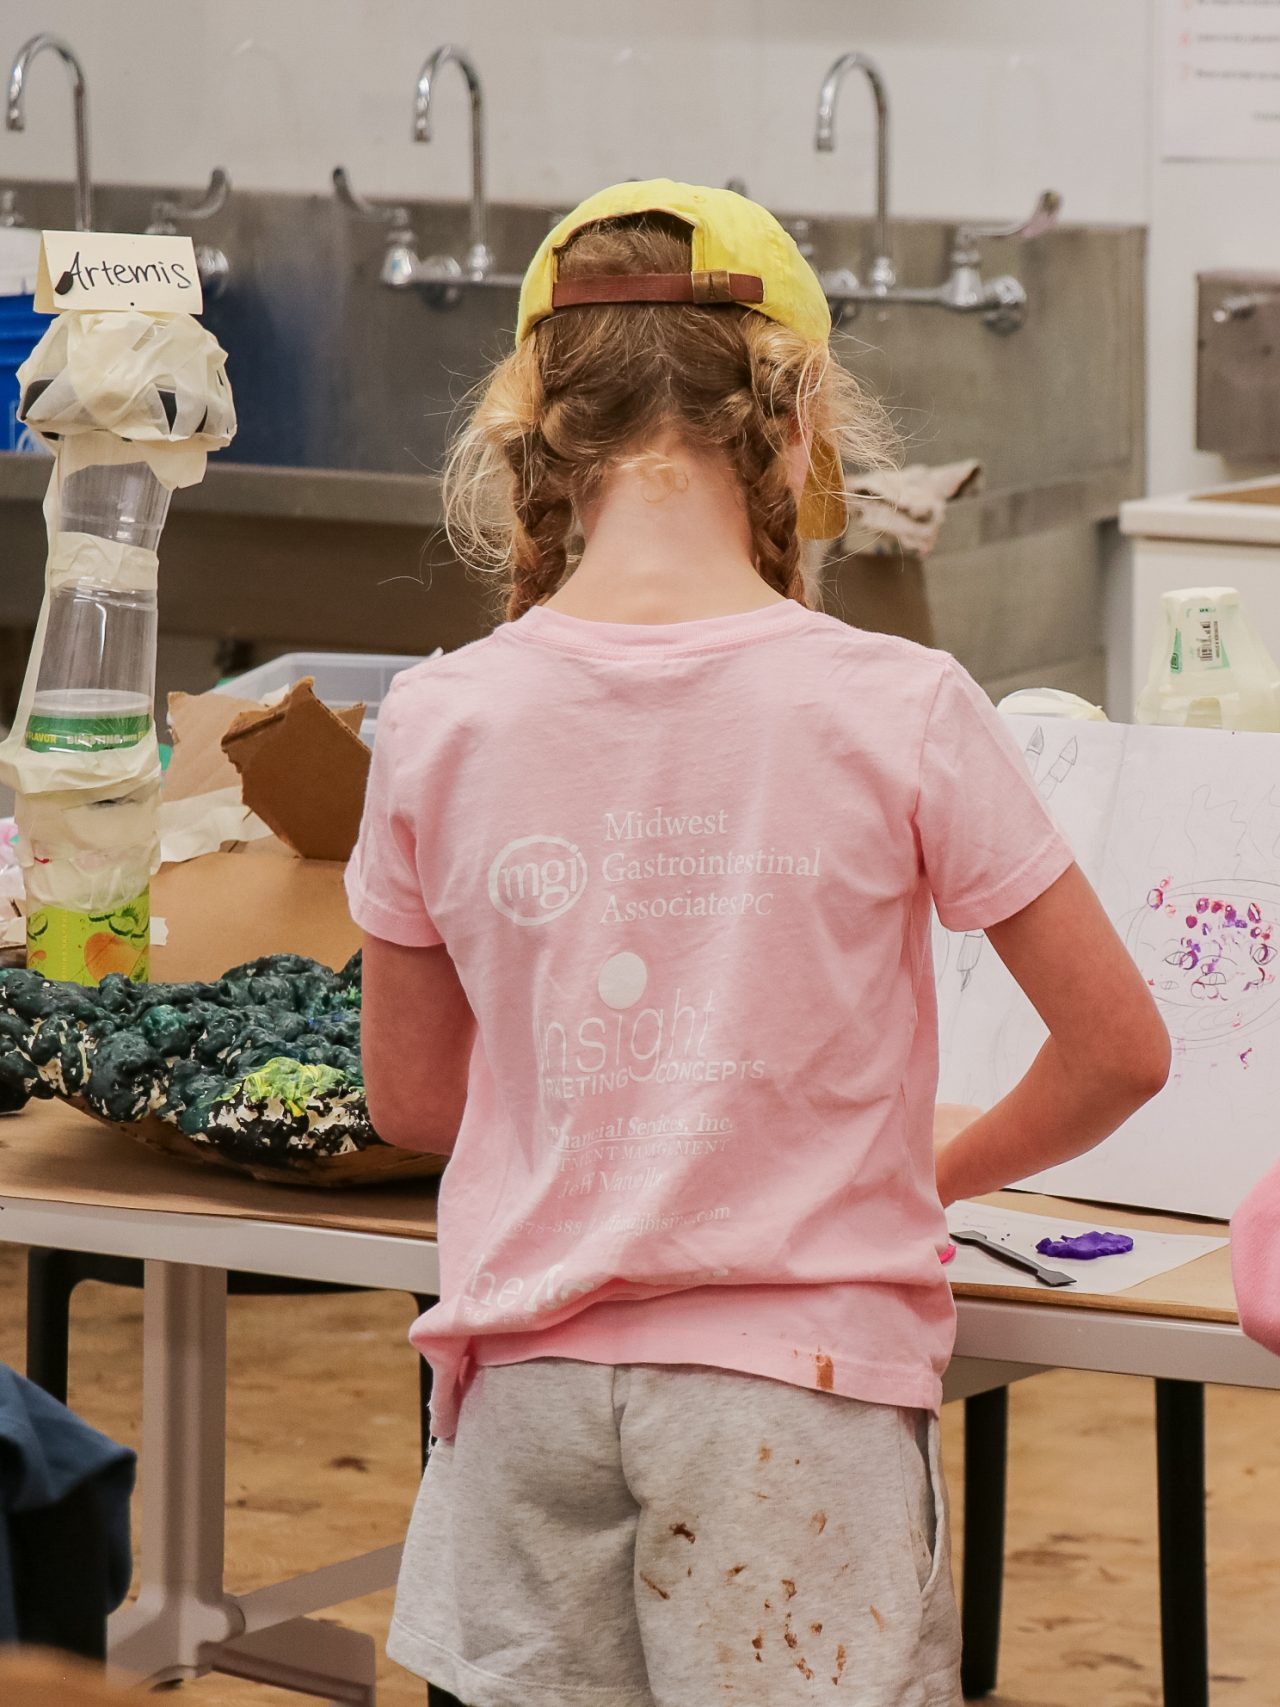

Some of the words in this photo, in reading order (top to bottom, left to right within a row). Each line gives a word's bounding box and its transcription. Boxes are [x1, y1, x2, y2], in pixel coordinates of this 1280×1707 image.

[57, 251, 192, 290] Artemis
[604, 807, 729, 841] Midwest
[500, 843, 580, 910] mgi
[601, 847, 822, 883] Gastrointestinal
[655, 1059, 766, 1084] CONCEPTS
[695, 1112, 734, 1132] Inc.
